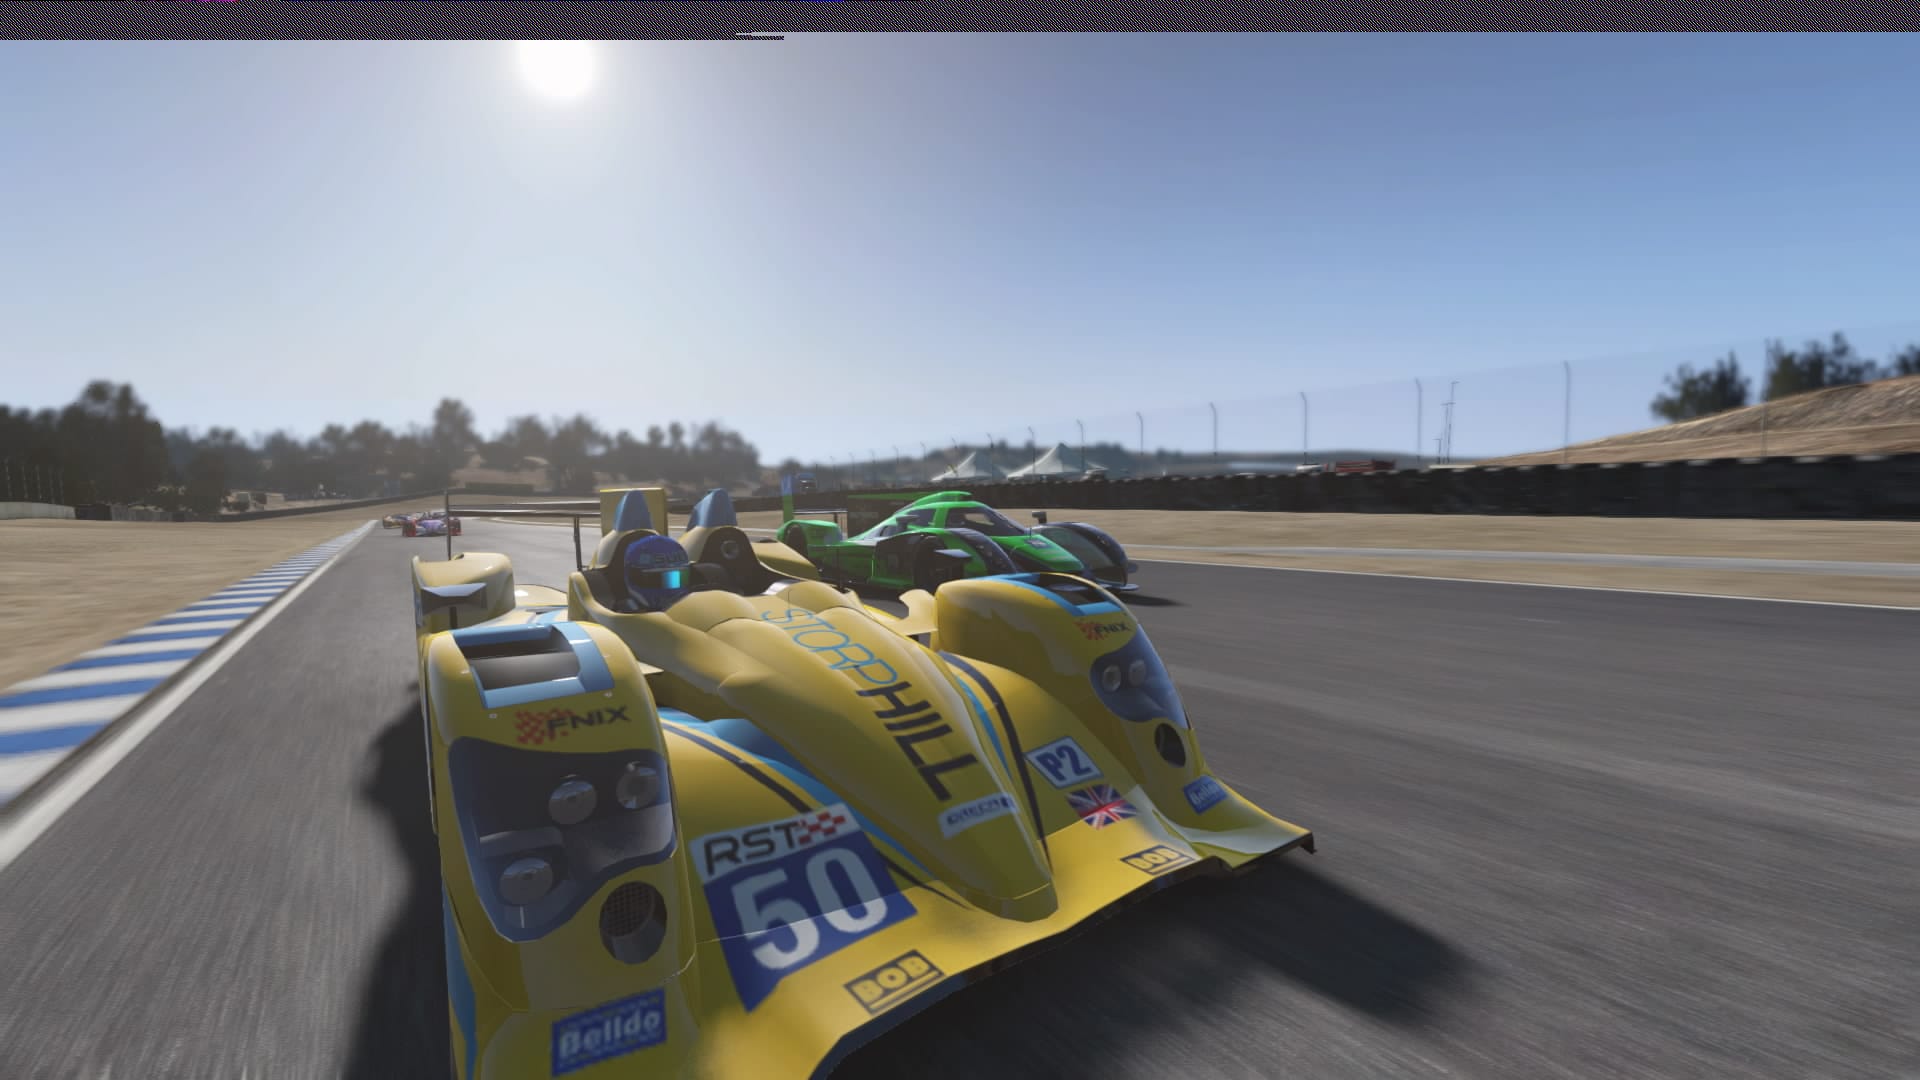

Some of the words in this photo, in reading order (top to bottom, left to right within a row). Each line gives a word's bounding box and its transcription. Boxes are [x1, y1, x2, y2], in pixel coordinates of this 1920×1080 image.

[1036, 744, 1092, 782] P2
[703, 820, 800, 877] RST
[731, 847, 888, 970] 50
[849, 954, 931, 1004] BOB
